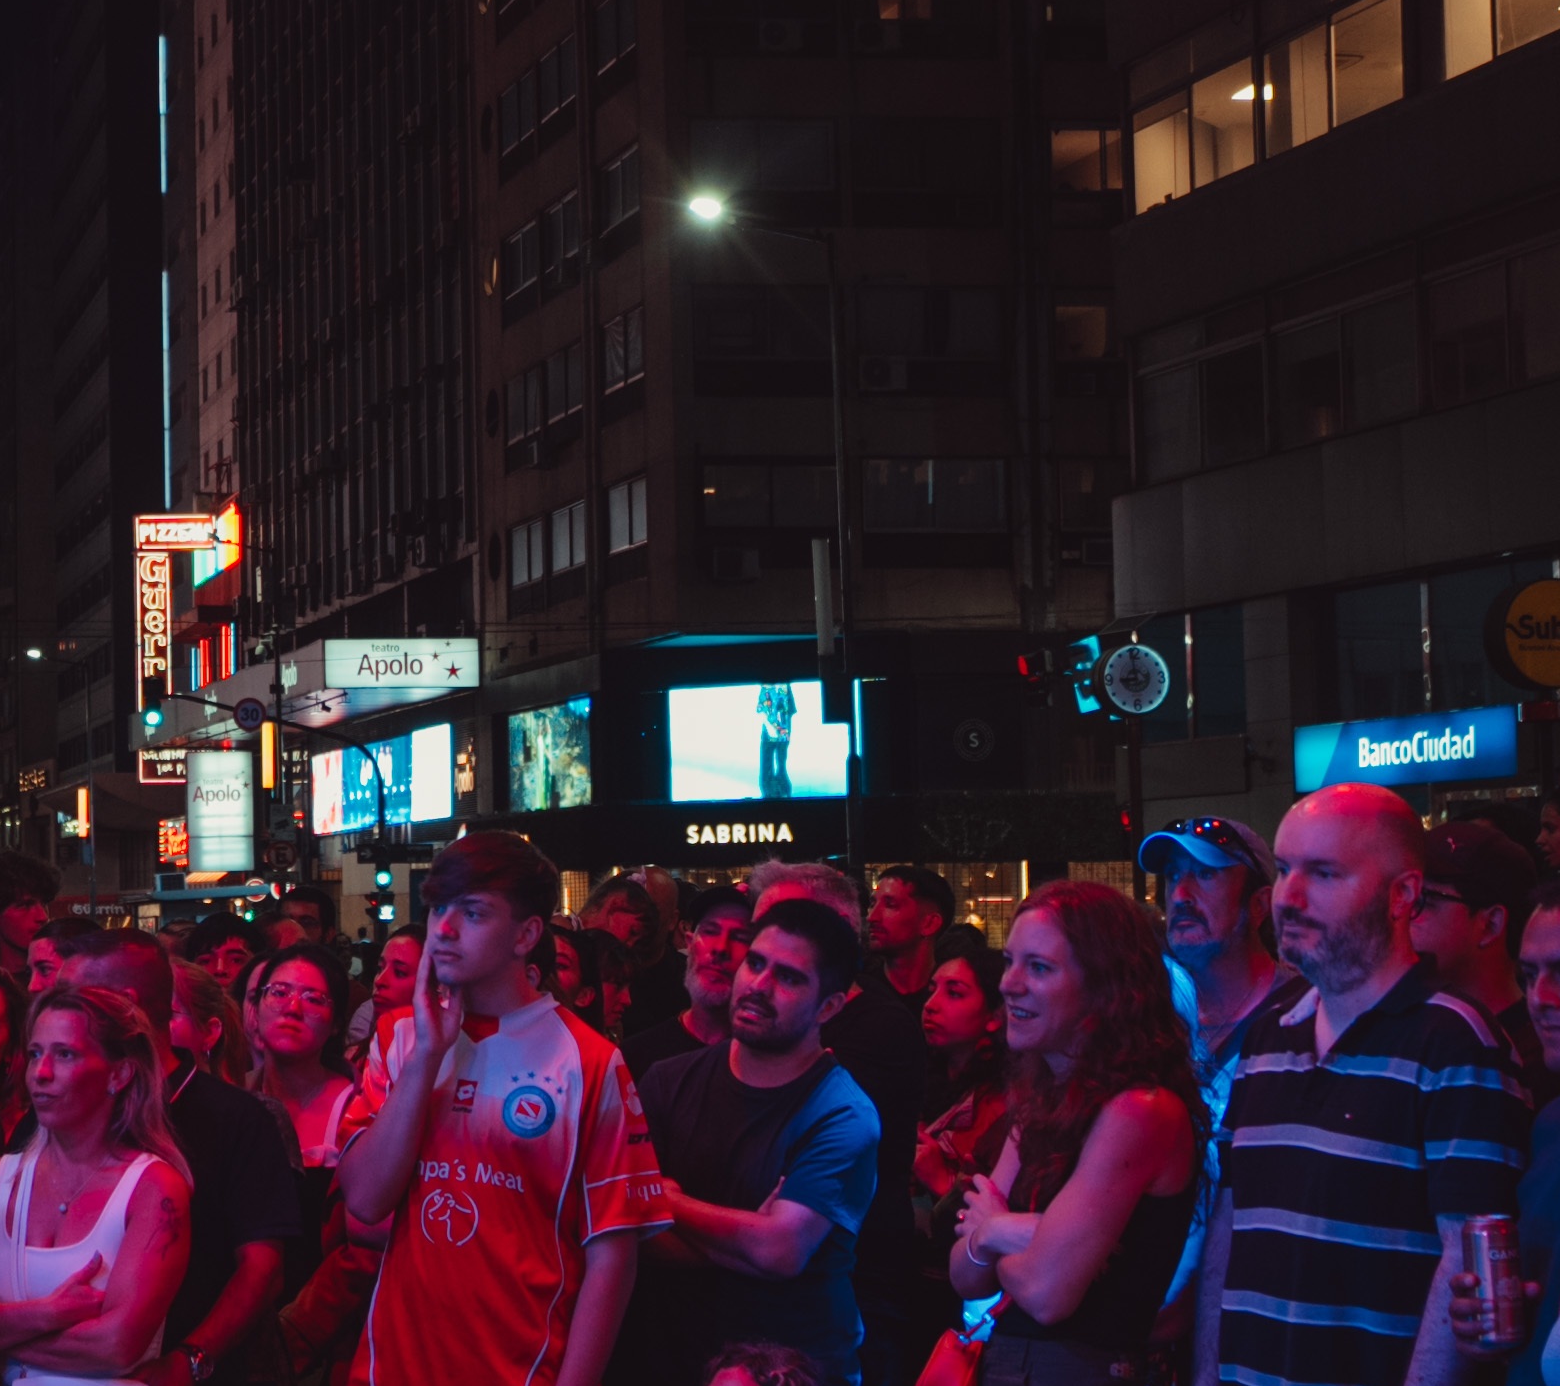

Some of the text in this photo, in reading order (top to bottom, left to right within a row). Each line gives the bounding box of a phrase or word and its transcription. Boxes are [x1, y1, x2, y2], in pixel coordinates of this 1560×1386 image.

[371, 643, 400, 653] teatro
[358, 653, 424, 681] Apolo
[1105, 673, 1113, 686] 9
[1157, 670, 1166, 684] 3
[1133, 699, 1142, 711] 6
[241, 707, 260, 723] 30
[1358, 725, 1475, 769] BancoCiudad
[192, 786, 242, 806] Apolo
[685, 823, 794, 845] SABRINA
[475, 1162, 525, 1193] Meat
